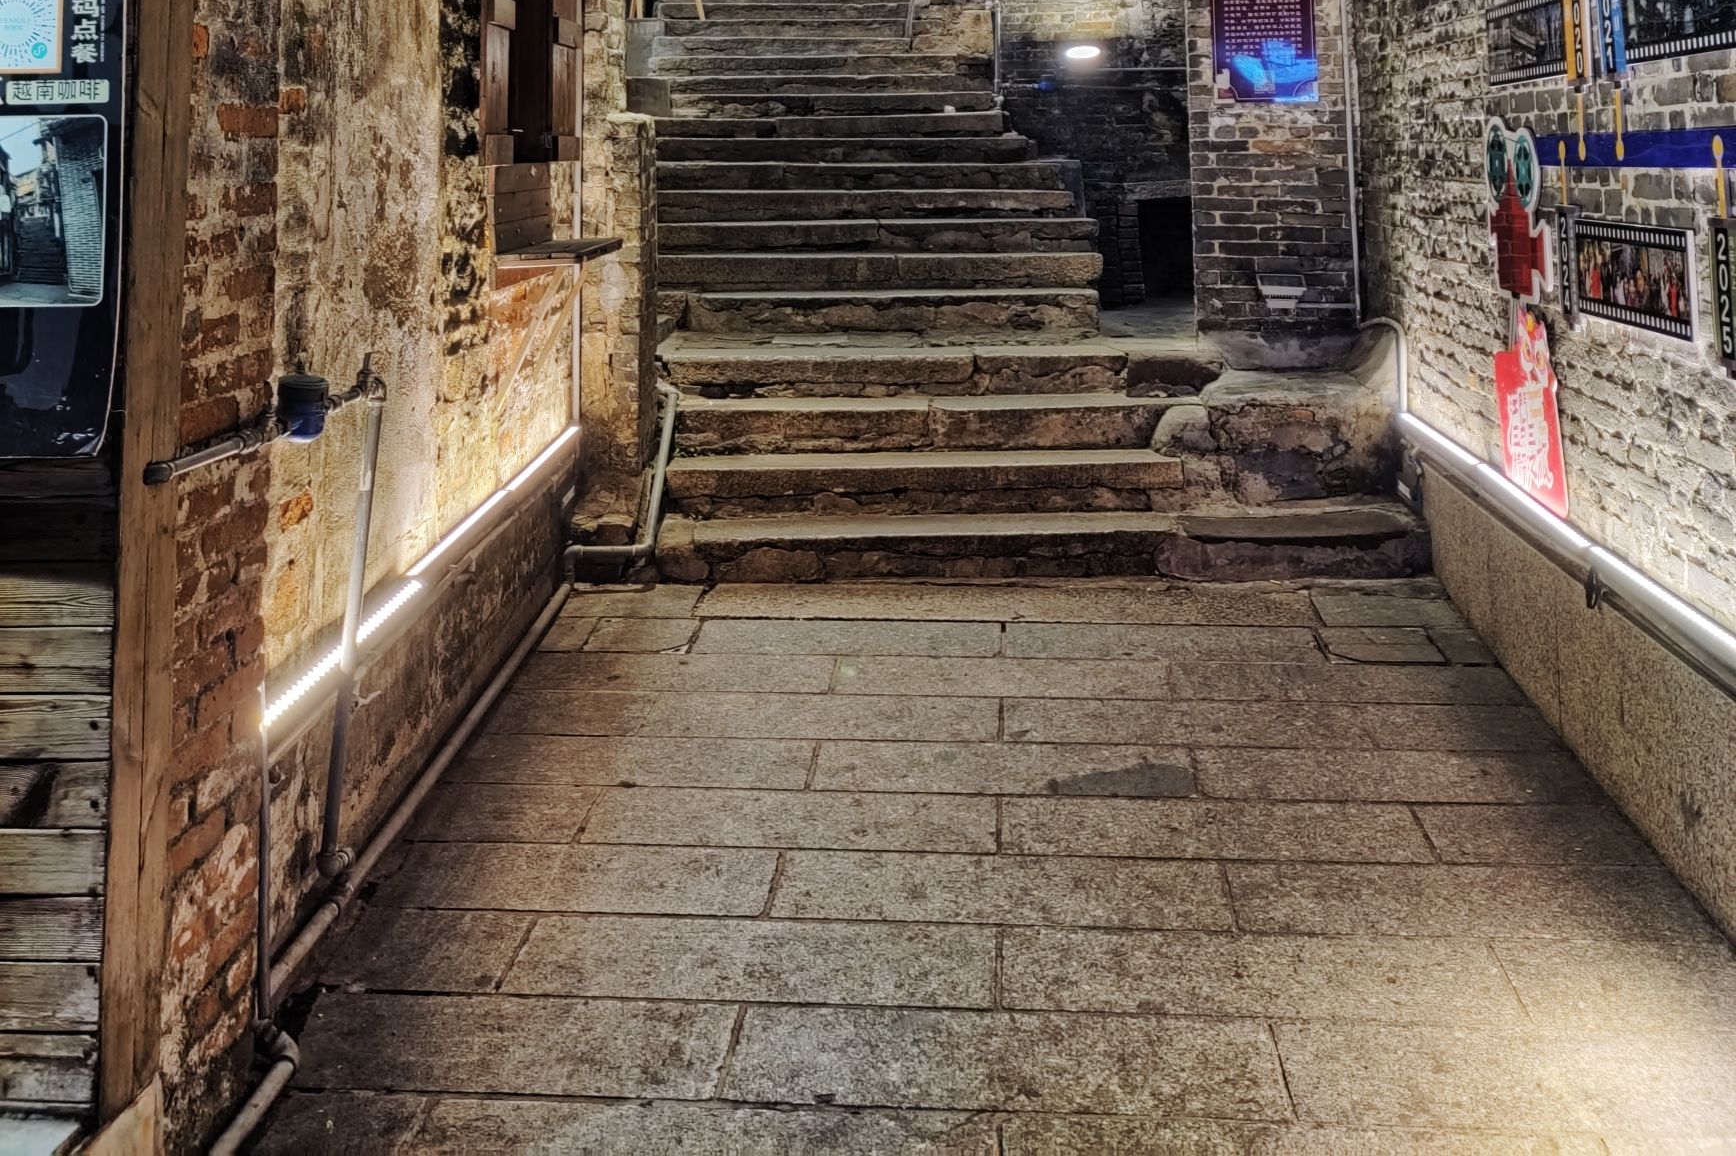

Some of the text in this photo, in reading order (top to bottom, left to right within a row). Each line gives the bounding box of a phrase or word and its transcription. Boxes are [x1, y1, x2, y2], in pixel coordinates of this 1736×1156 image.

[12, 79, 102, 102] 越南咖啡
[1560, 216, 1571, 310] 2024
[1717, 232, 1733, 354] 2025
